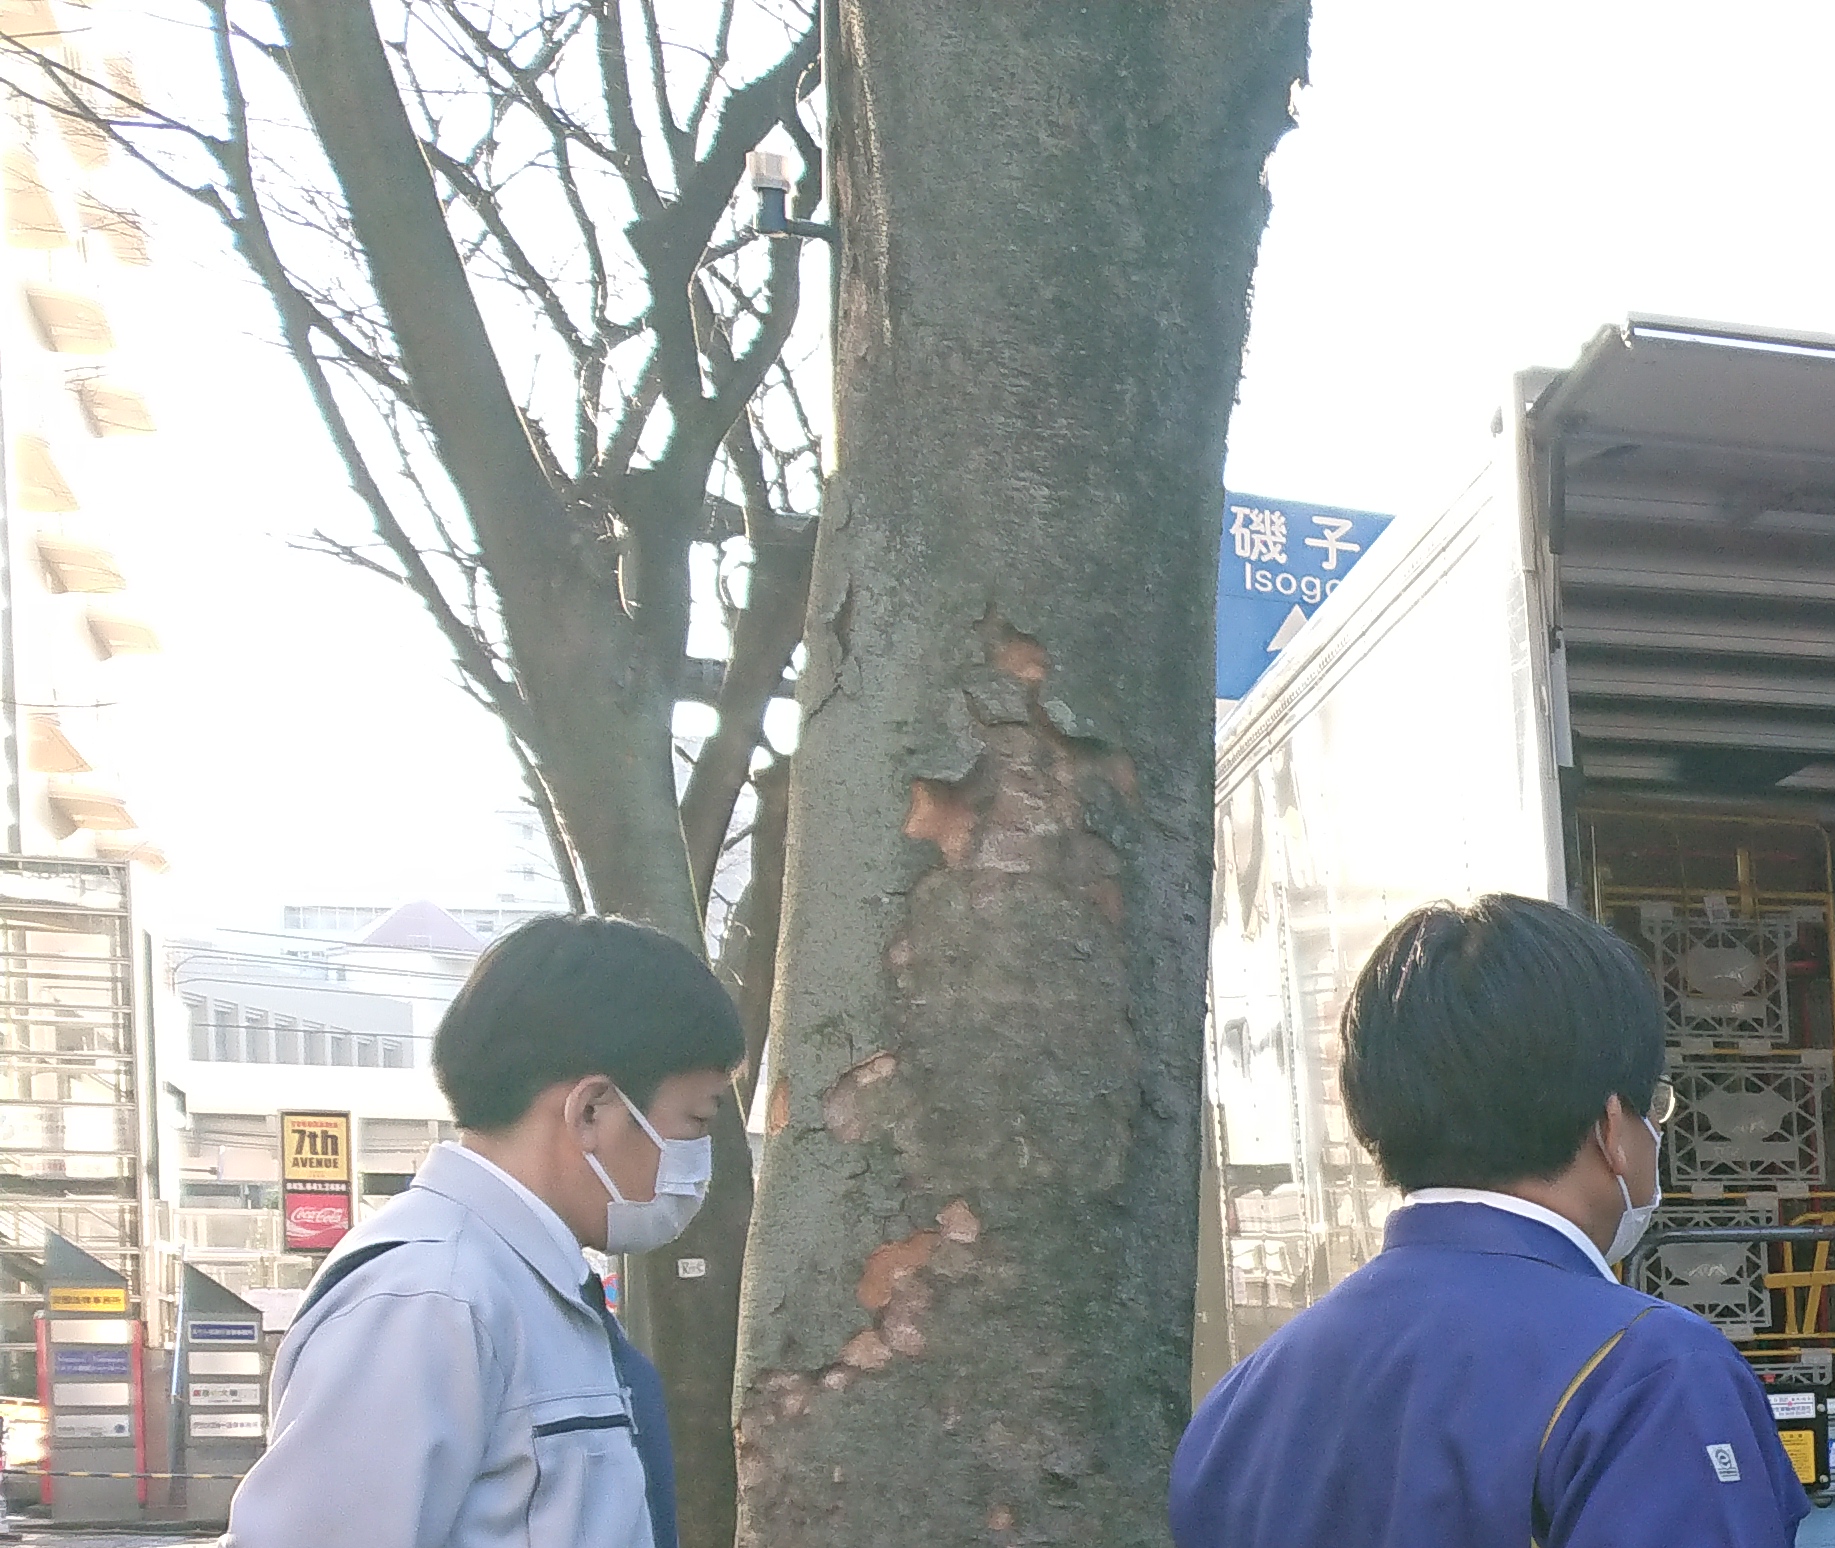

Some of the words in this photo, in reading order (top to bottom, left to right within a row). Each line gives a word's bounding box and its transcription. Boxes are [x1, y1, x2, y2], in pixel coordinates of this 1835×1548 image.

[1229, 505, 1361, 570] 磯子
[291, 1129, 339, 1156] 7th
[291, 1157, 339, 1169] AVENUE
[291, 1206, 344, 1223] Coca-Cola
